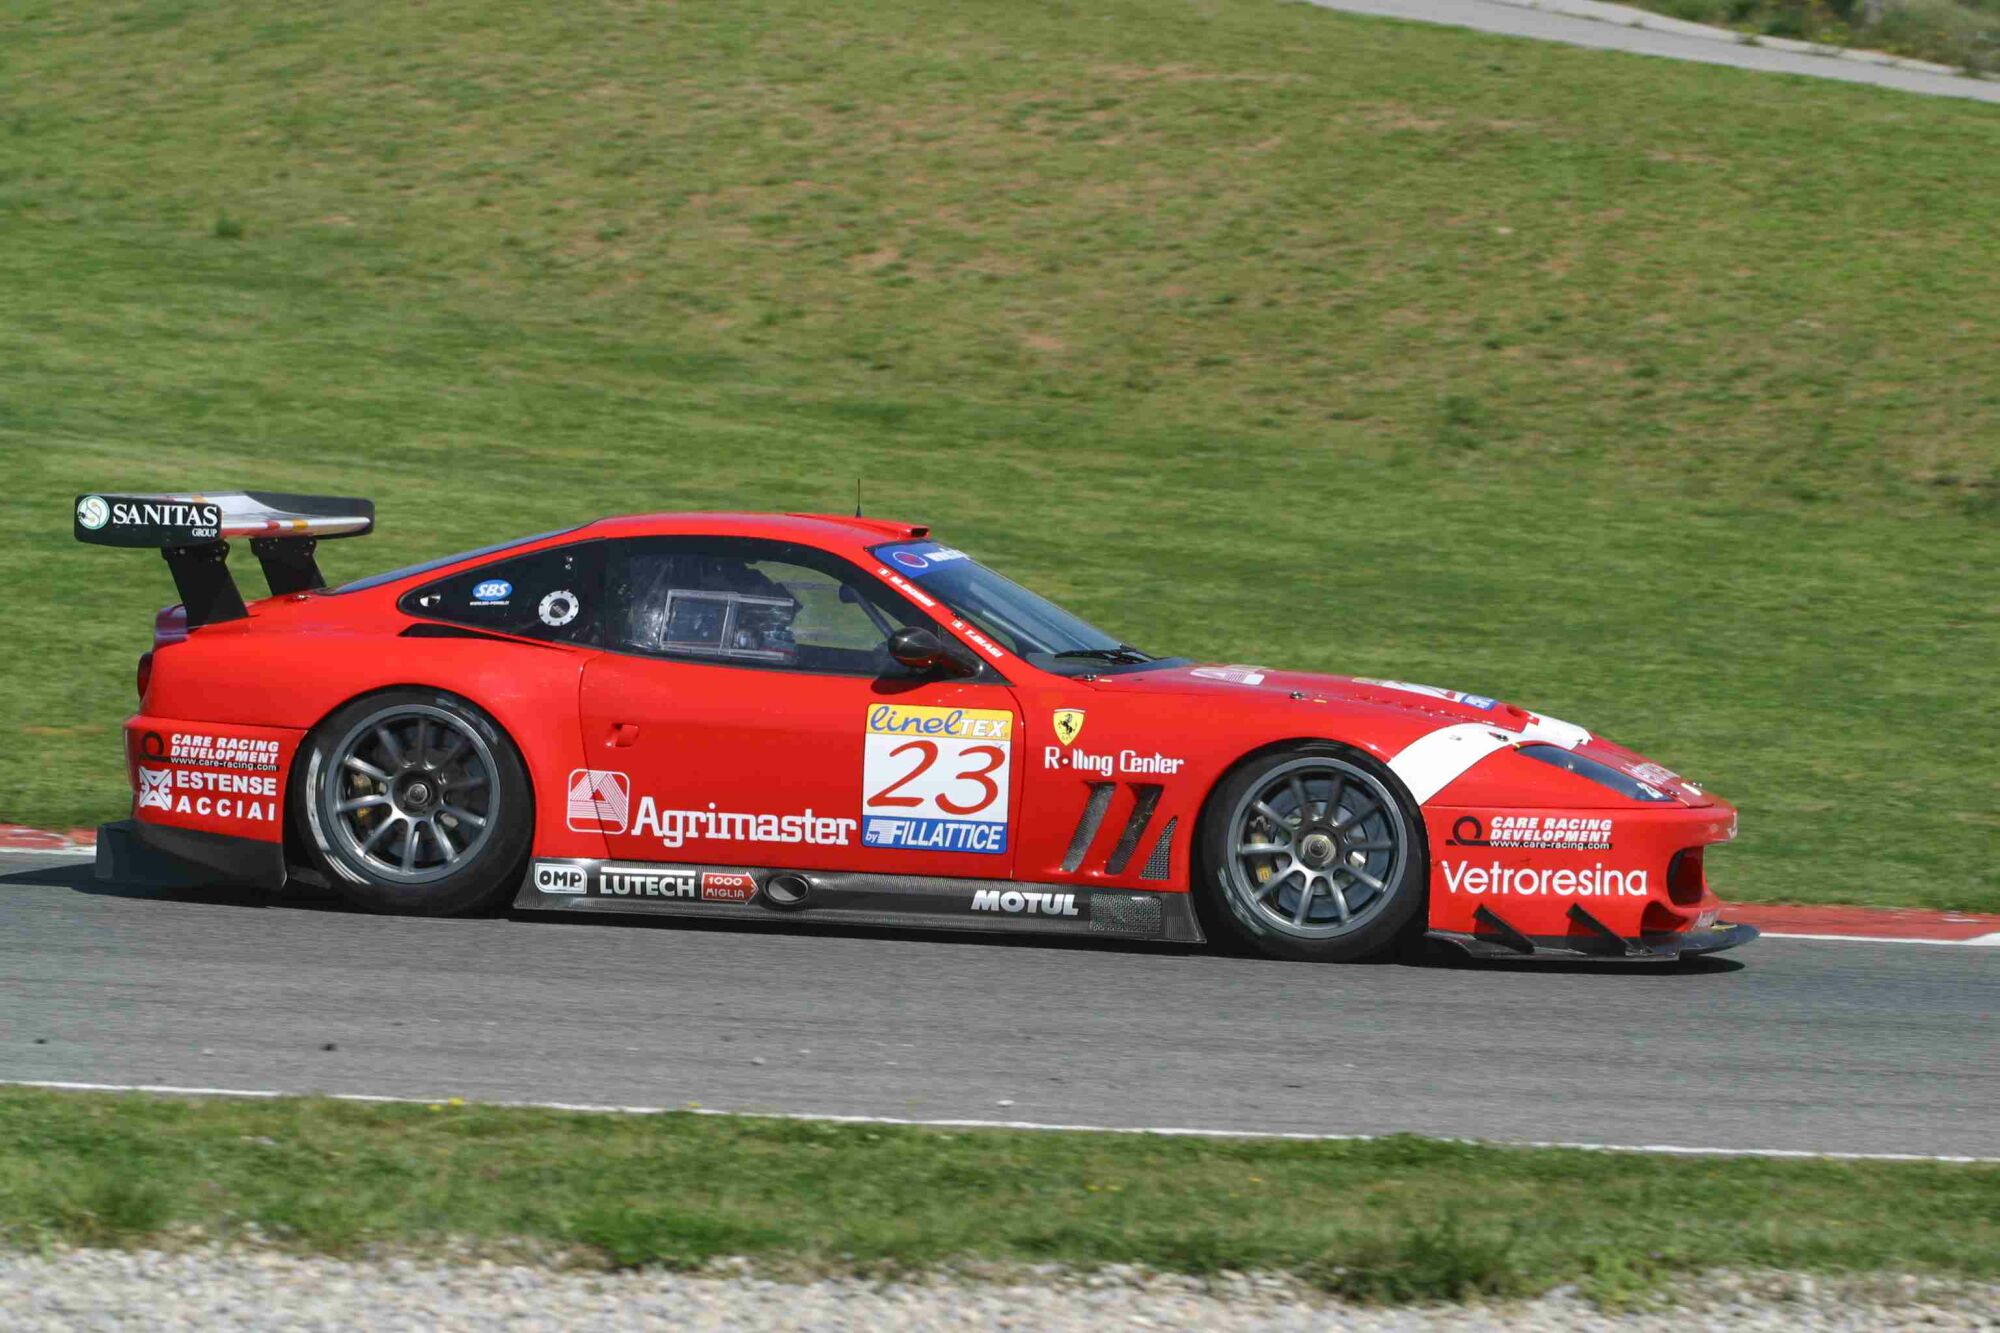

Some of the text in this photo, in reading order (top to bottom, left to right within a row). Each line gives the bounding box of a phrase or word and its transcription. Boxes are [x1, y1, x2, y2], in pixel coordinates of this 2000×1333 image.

[112, 503, 218, 527] SANITAS
[191, 527, 217, 537] GROUP
[475, 583, 509, 597] SBS
[171, 733, 279, 752] CARE RACING
[170, 745, 278, 764] DEVELOPMENT
[170, 756, 277, 771] www.care-racing.com
[1119, 749, 1184, 774] Center
[176, 770, 277, 796] ESTENSE
[866, 739, 1006, 816] 23
[175, 795, 276, 821] ACCIAI
[631, 796, 857, 849] Agrimaster
[1490, 816, 1612, 831] CARE RACING
[865, 833, 878, 843] by
[1489, 828, 1611, 843] DEVELOPMENT
[1489, 840, 1610, 851] www.care-racing.com
[539, 870, 583, 888] OMP
[599, 874, 696, 898] LUTECH
[708, 876, 743, 886] 1000
[1441, 860, 1648, 896] Vetroresina
[705, 887, 745, 899] MIGLIA
[970, 889, 1079, 916] MOTUL
